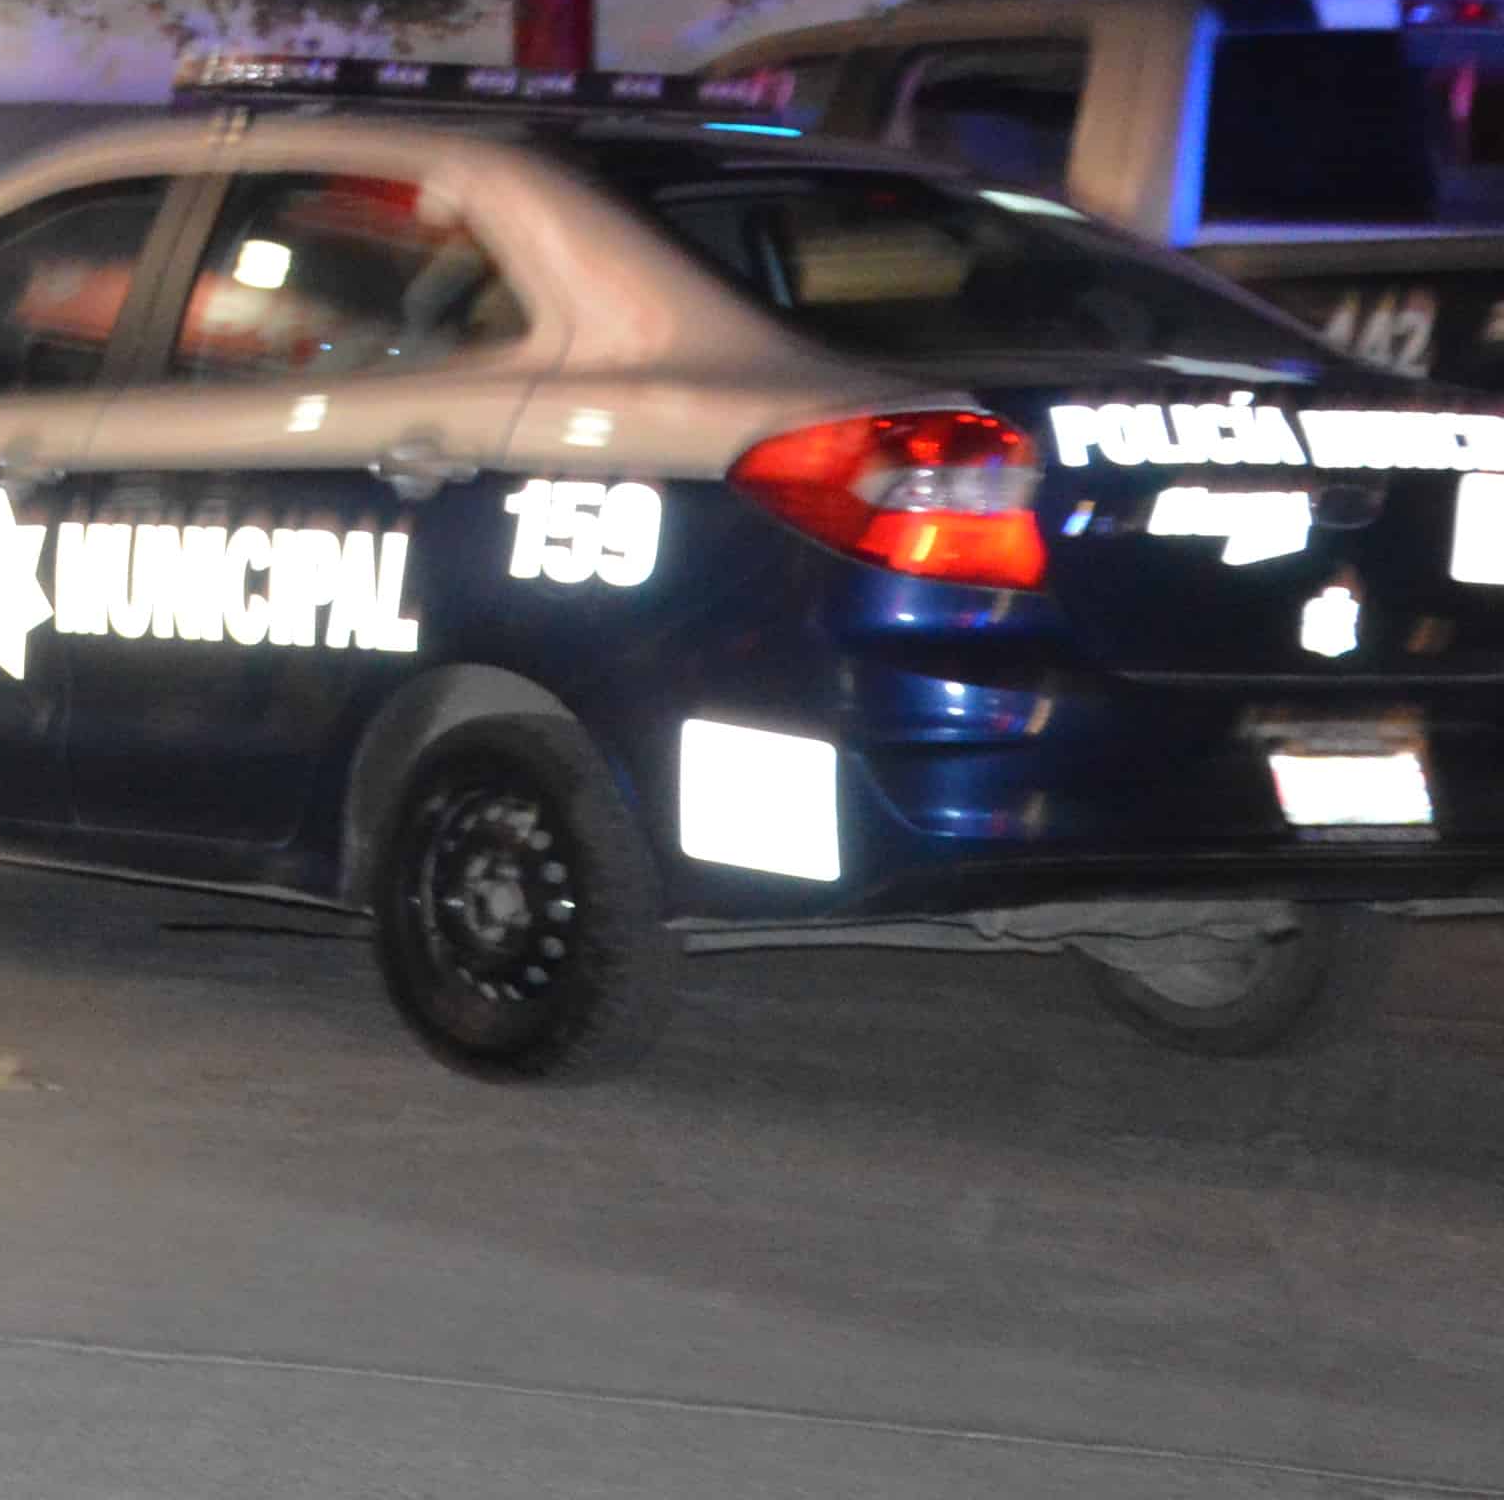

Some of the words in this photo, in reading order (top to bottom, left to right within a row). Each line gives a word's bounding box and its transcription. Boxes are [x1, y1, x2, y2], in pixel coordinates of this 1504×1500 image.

[1050, 391, 1310, 467] POLICÍA
[54, 522, 419, 652] MUNICIPAL
[504, 478, 663, 587] 159
